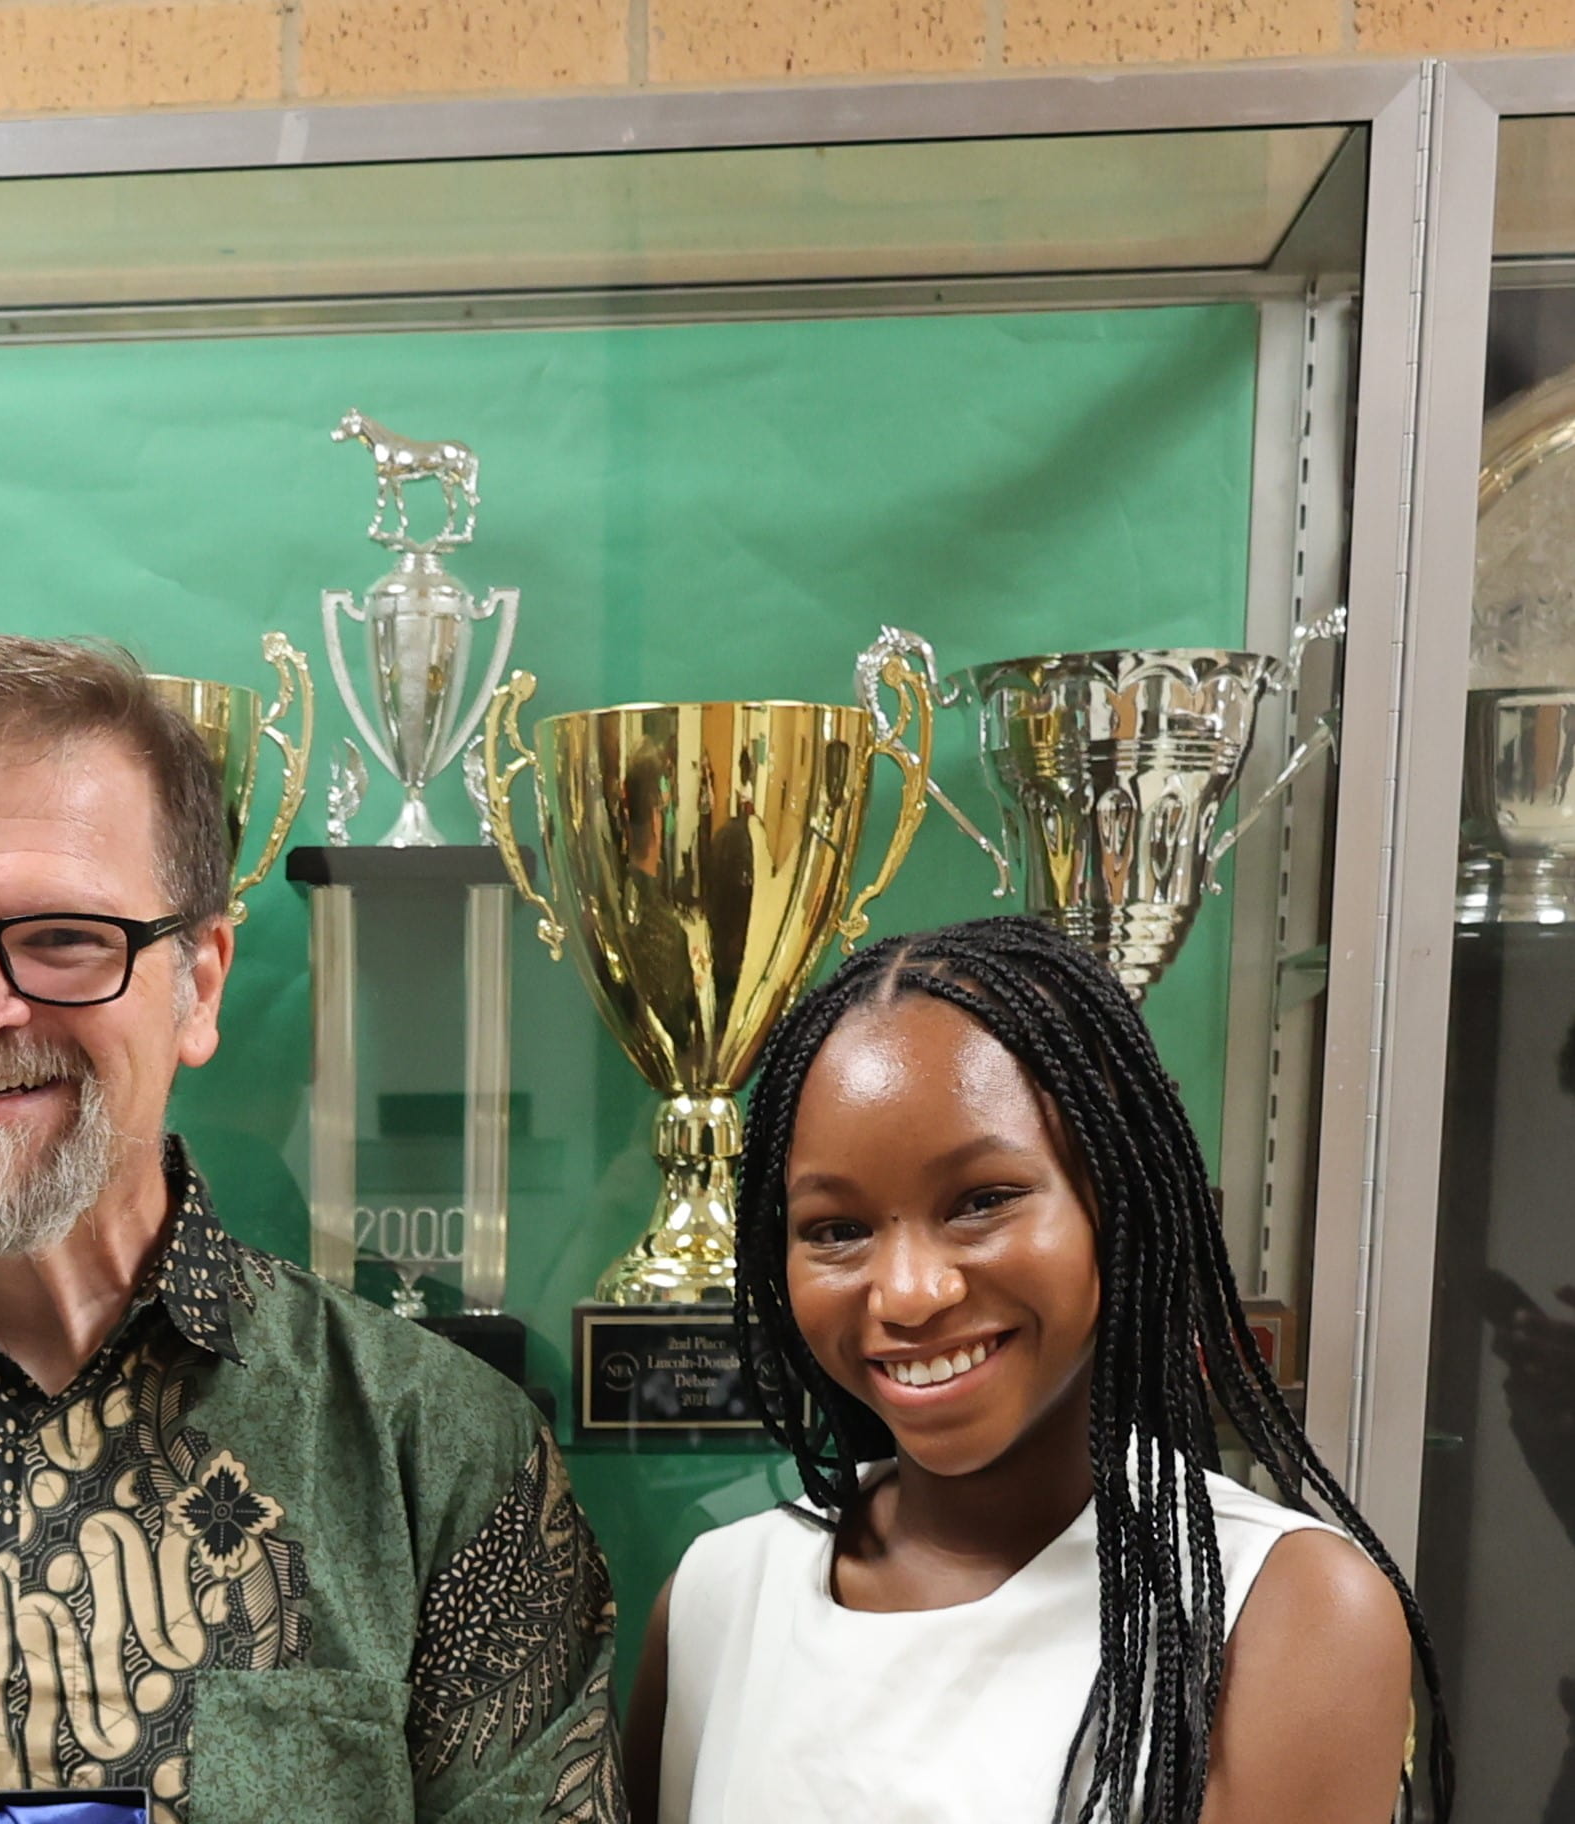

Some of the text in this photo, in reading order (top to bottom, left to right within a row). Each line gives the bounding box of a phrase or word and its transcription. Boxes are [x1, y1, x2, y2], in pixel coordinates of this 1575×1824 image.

[354, 1206, 465, 1259] 2000
[668, 1336, 726, 1350] 2nd Place
[647, 1354, 741, 1370] Lincoln-Dougla
[675, 1373, 717, 1388] Debate
